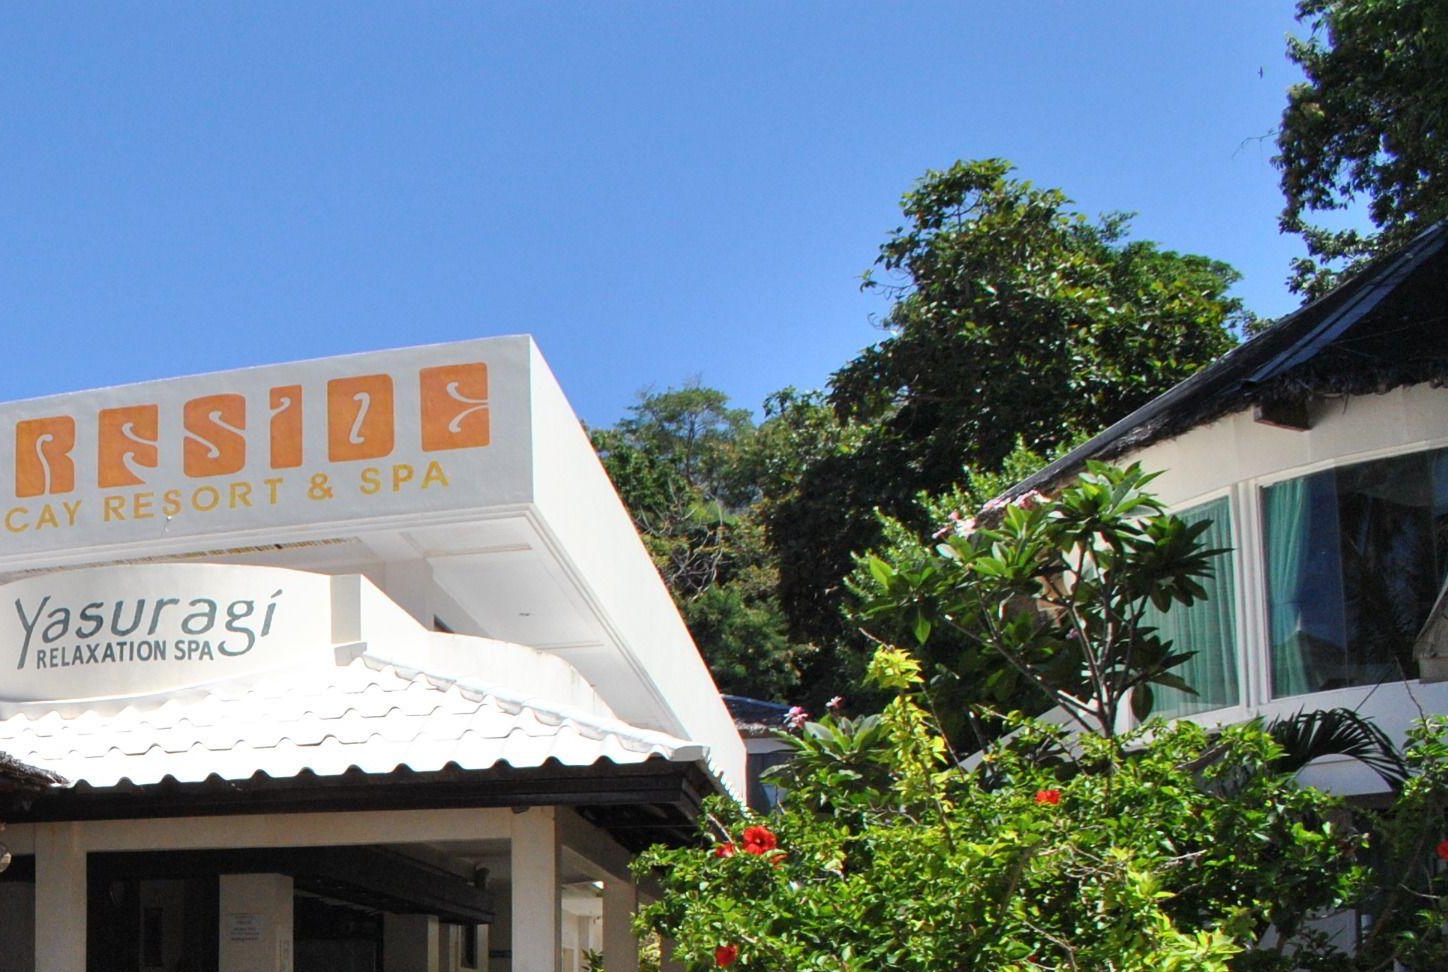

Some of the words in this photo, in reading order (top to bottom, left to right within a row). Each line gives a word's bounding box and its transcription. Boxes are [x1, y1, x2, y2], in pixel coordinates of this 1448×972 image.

[104, 478, 284, 522] RESORT
[307, 472, 334, 500] &
[359, 460, 449, 495] SPA
[15, 589, 283, 670] Yasuragi
[36, 640, 167, 669] RELAXATION
[174, 640, 214, 661] SPA
